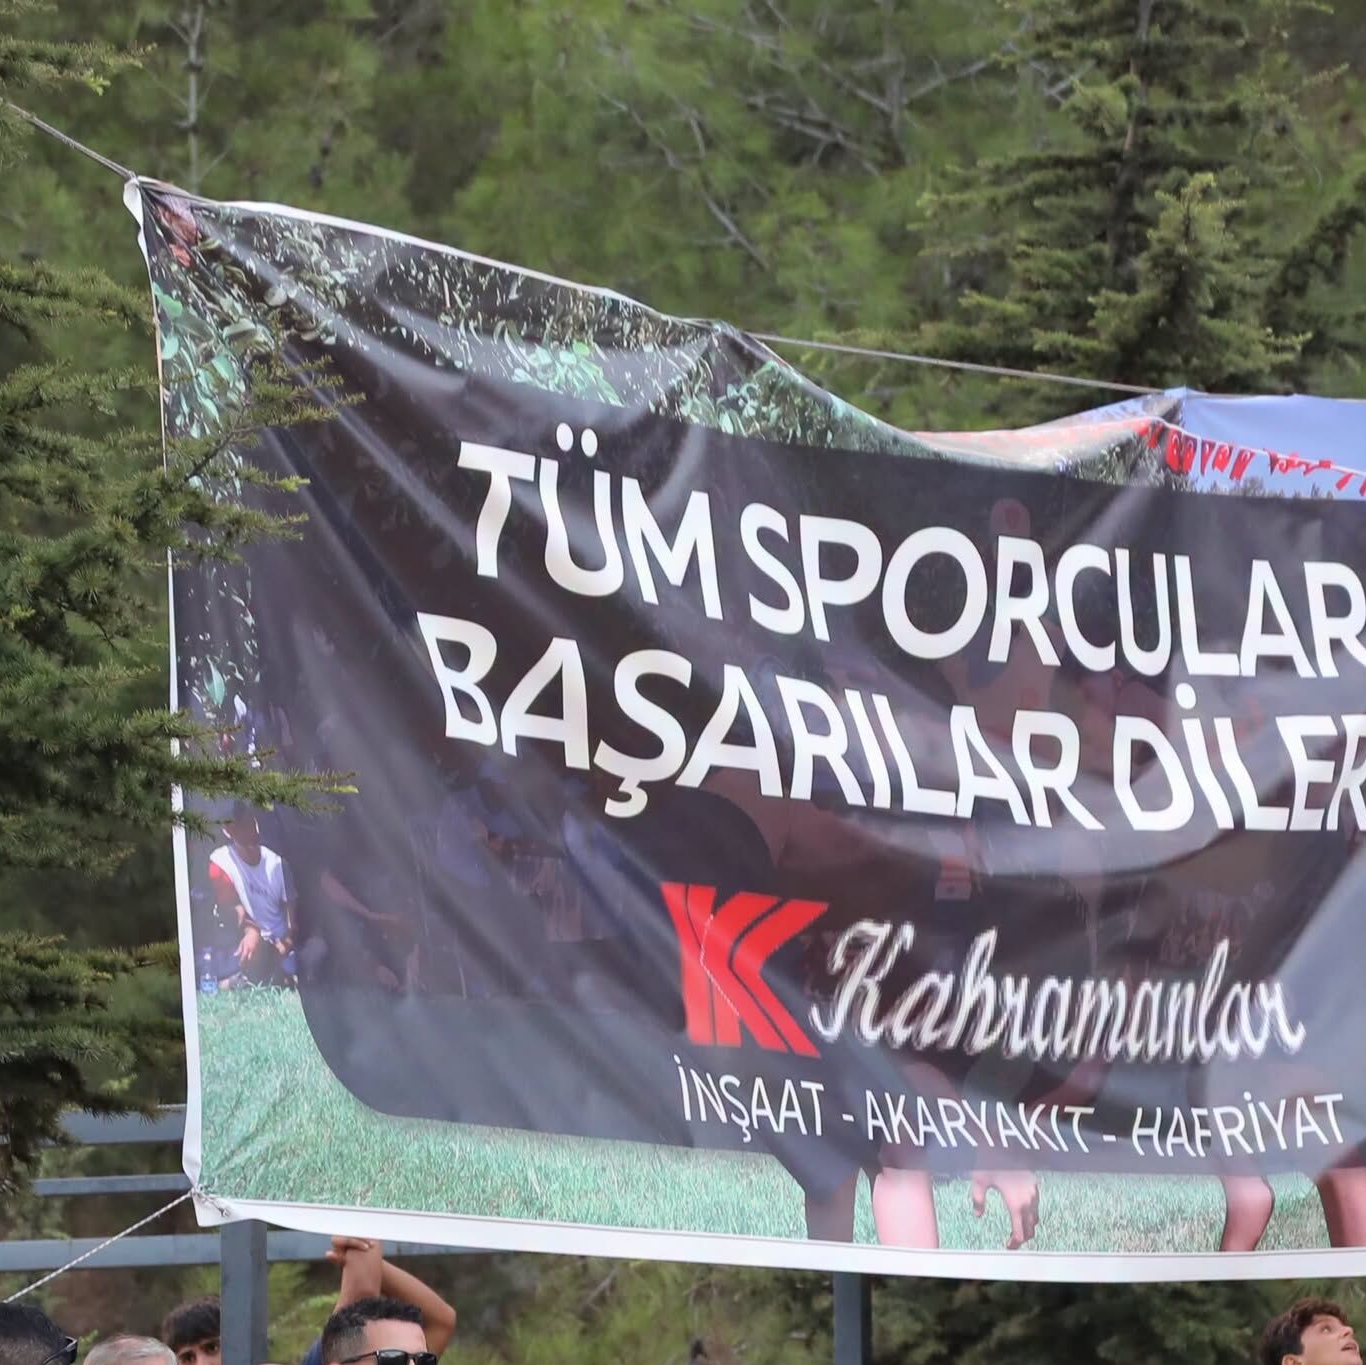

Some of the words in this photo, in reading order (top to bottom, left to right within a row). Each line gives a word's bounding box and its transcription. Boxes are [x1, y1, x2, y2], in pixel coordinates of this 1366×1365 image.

[457, 427, 722, 620] TÜM
[416, 611, 1105, 831] BAŞARILAR
[809, 917, 1307, 1064] Kahramanlar
[673, 1054, 825, 1143] İNŞAAT
[864, 1089, 1095, 1153] AKARYAKIT
[1131, 1091, 1345, 1157] HAFRİYAT
